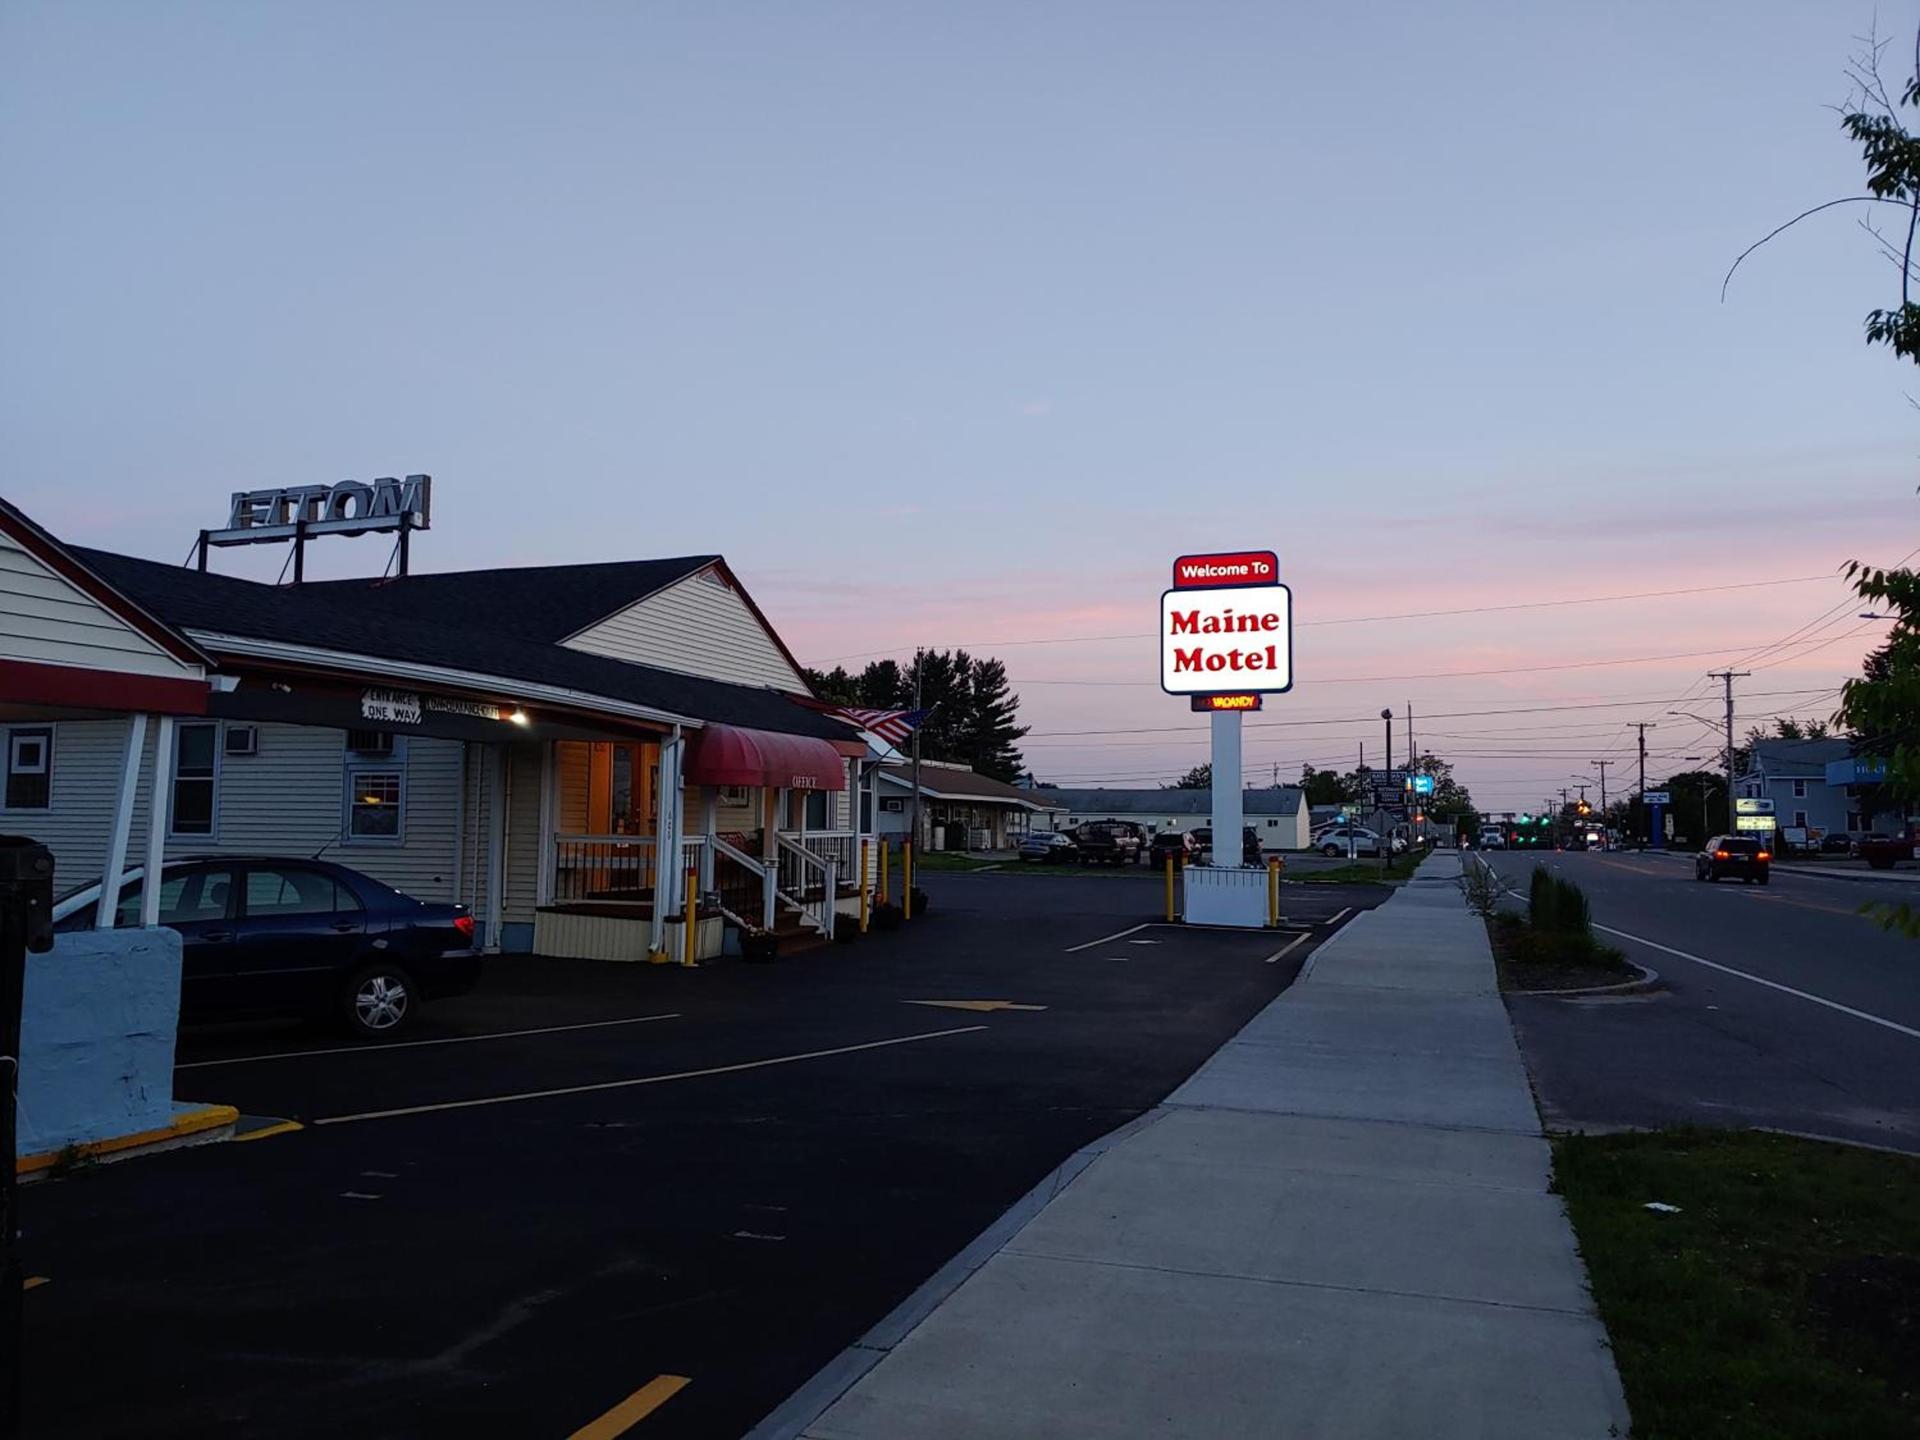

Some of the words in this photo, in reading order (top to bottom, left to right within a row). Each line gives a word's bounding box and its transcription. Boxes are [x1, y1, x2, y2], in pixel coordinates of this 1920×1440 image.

[1181, 564, 1248, 578] Welcome
[1252, 561, 1269, 574] To
[1170, 608, 1280, 635] Maine
[1173, 645, 1277, 672] Motel
[1212, 696, 1255, 708] VACANCY
[368, 705, 388, 718] ONE
[394, 708, 417, 721] WAY
[792, 776, 816, 789] OFFICE
